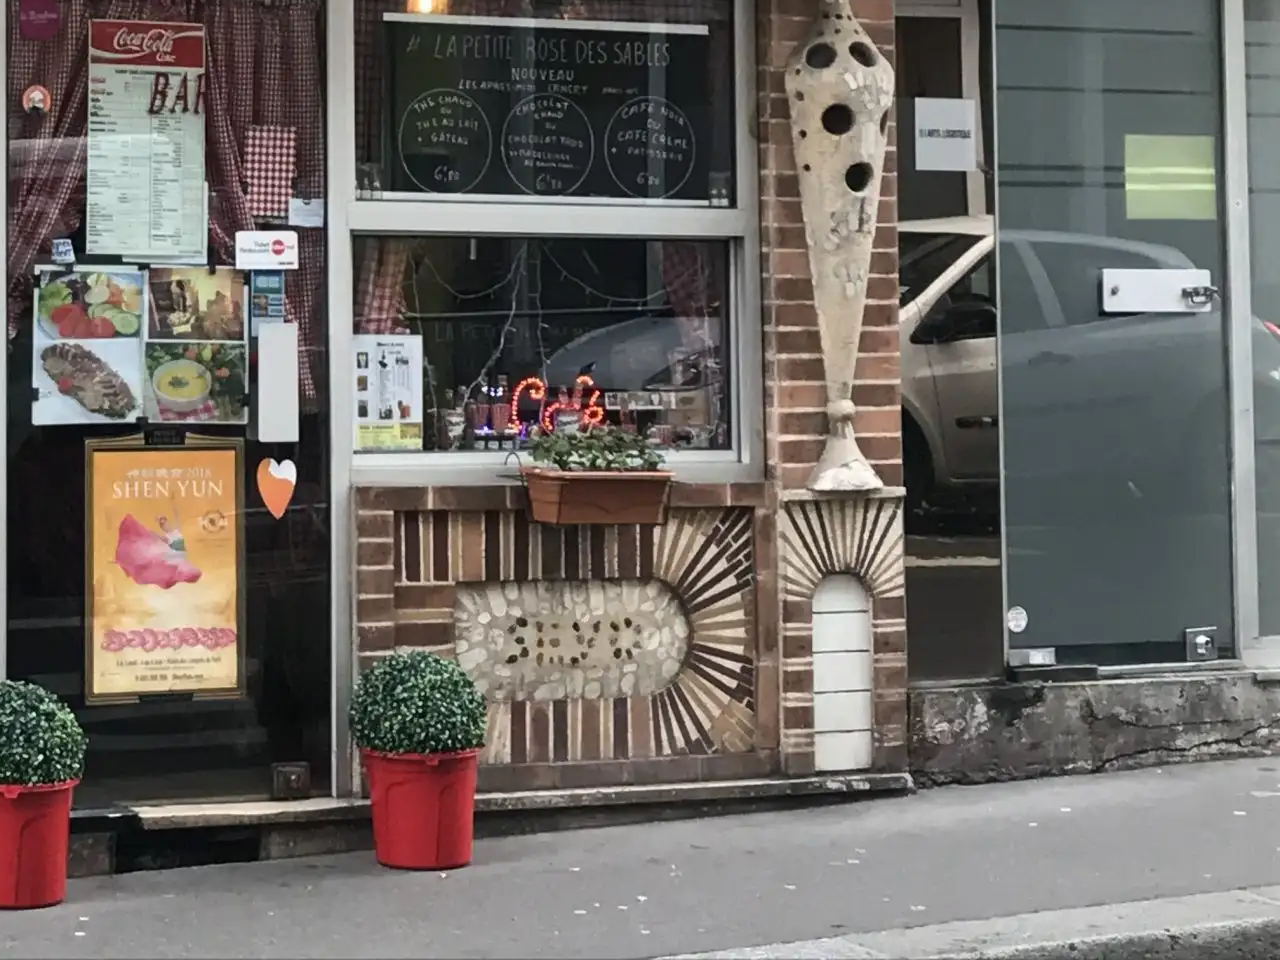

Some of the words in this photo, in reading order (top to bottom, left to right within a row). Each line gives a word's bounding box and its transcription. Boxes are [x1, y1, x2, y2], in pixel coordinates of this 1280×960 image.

[434, 34, 458, 59] LA
[463, 34, 513, 60] PETITE
[526, 37, 568, 65] ROSE
[576, 39, 607, 65] DES
[614, 41, 671, 67] SABLES
[511, 67, 574, 81] NOUVEAU
[113, 481, 169, 498] SHEN
[177, 479, 223, 497] YUN
